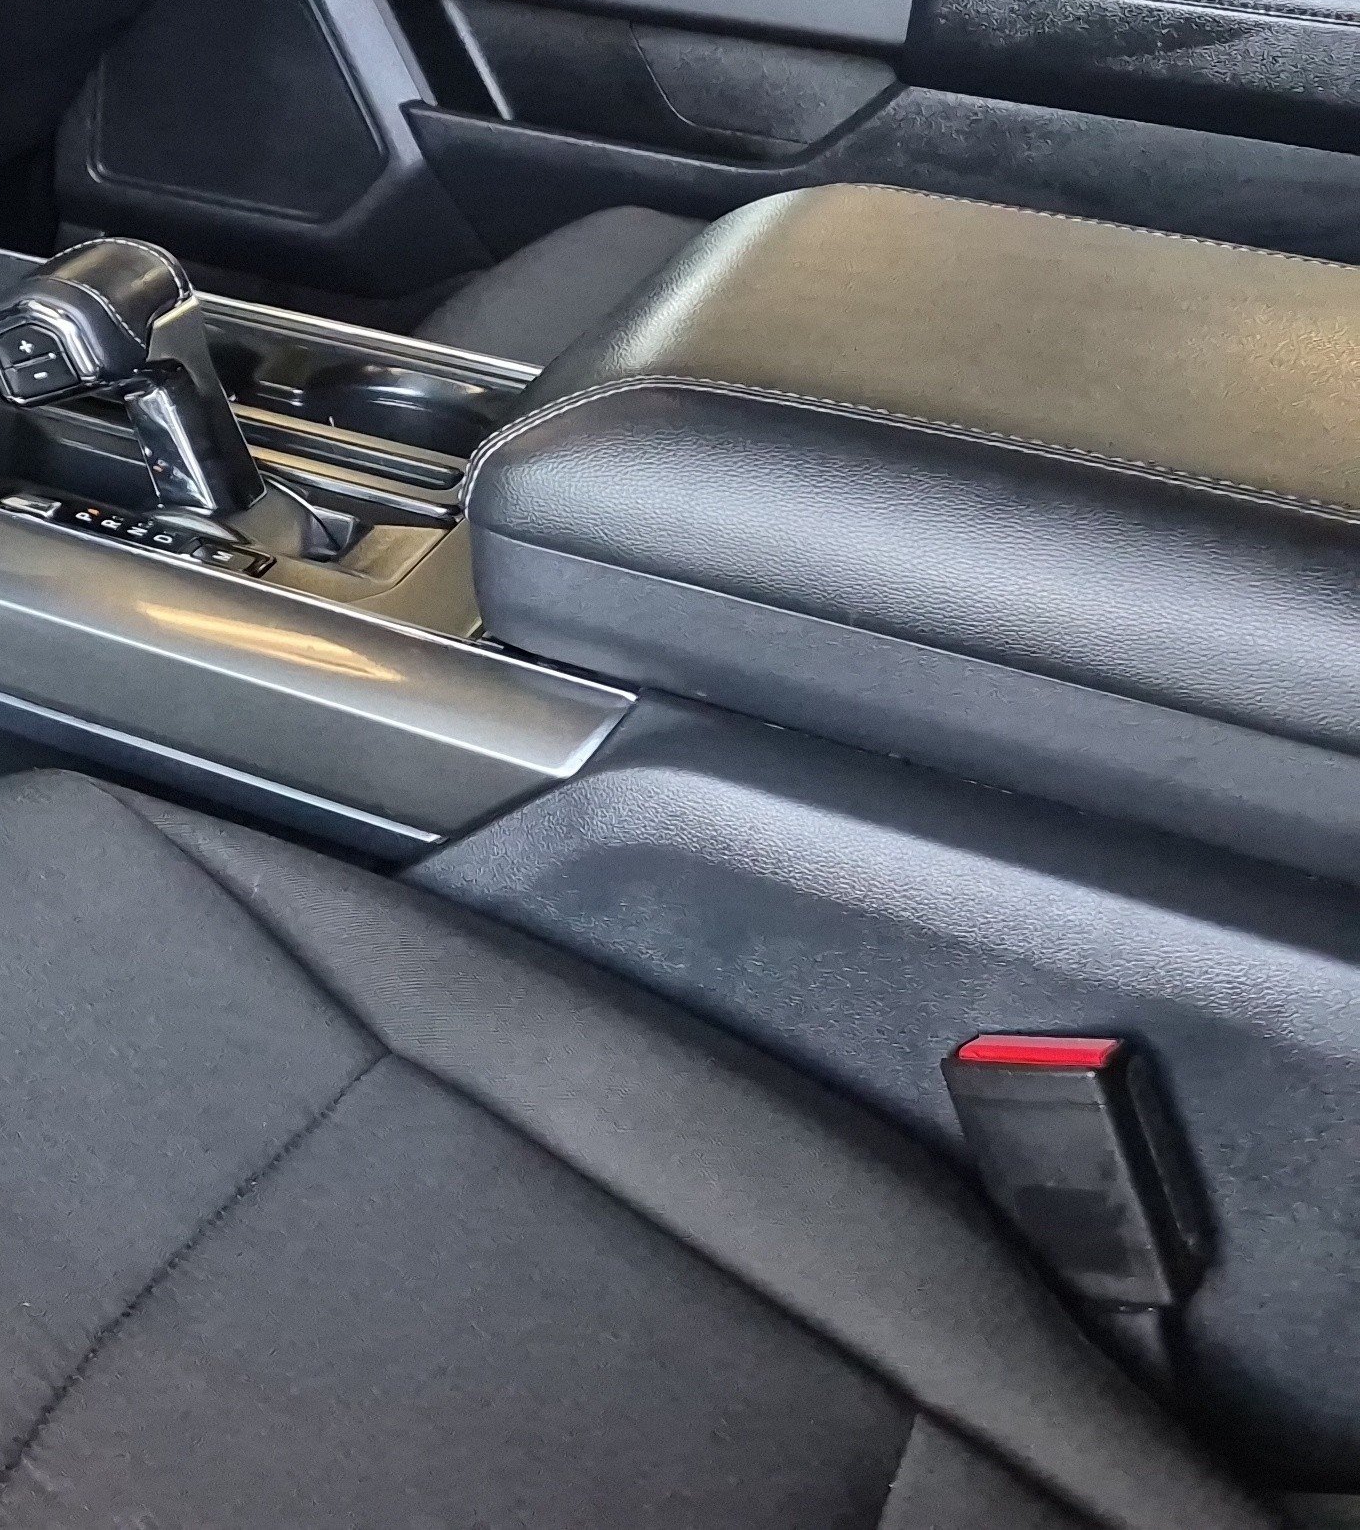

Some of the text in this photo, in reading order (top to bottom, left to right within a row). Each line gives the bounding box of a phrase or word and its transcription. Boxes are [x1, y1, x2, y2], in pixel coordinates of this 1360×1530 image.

[75, 511, 93, 522] P
[100, 518, 122, 531] R
[127, 525, 148, 537] N
[153, 534, 174, 545] D
[212, 550, 234, 562] M
